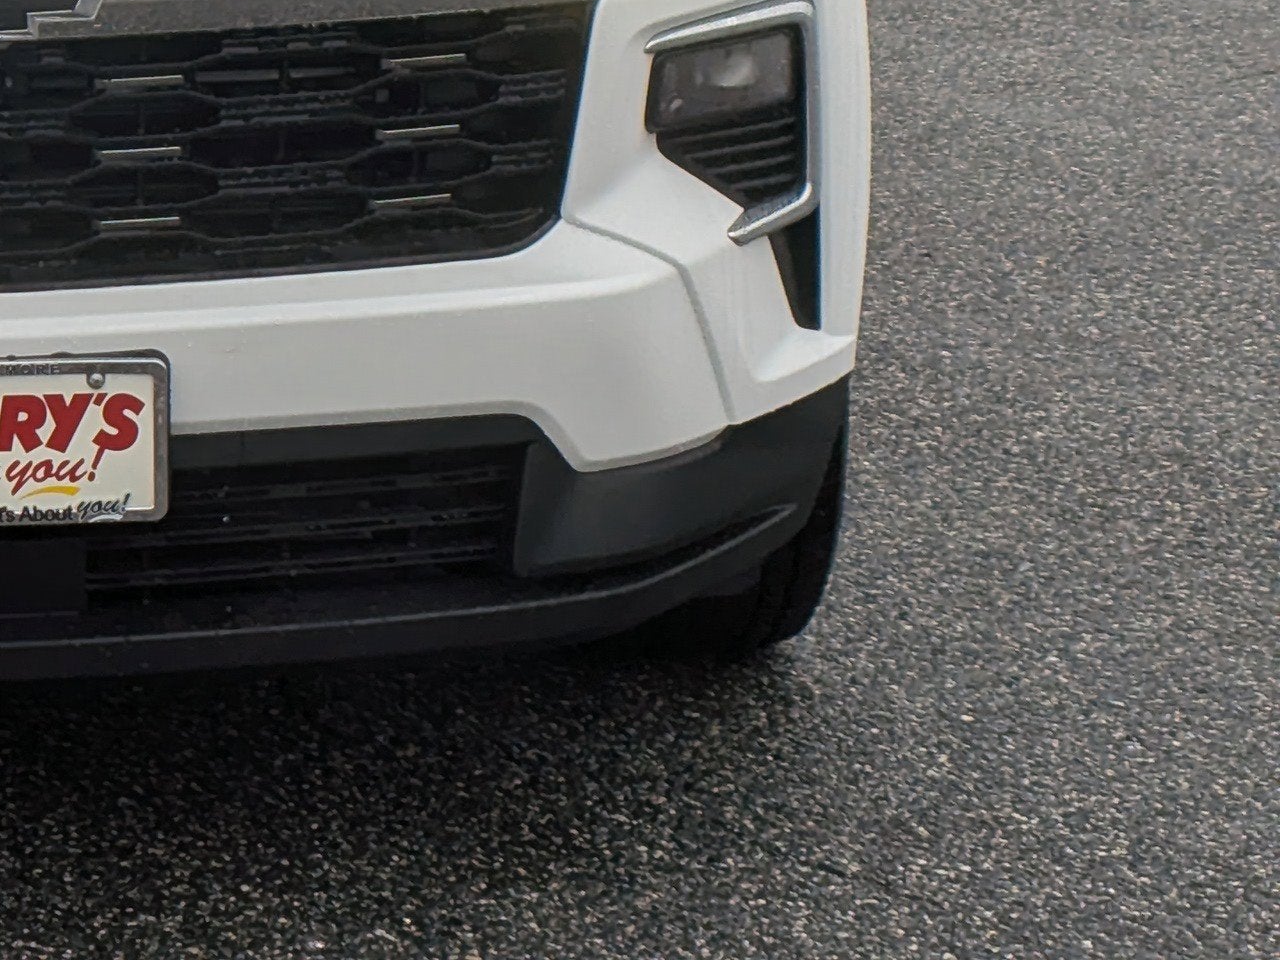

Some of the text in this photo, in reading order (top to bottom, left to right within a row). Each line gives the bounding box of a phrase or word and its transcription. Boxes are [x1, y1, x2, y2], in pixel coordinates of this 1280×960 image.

[5, 445, 104, 496] you!
[19, 504, 73, 522] About
[76, 492, 131, 520] you!
